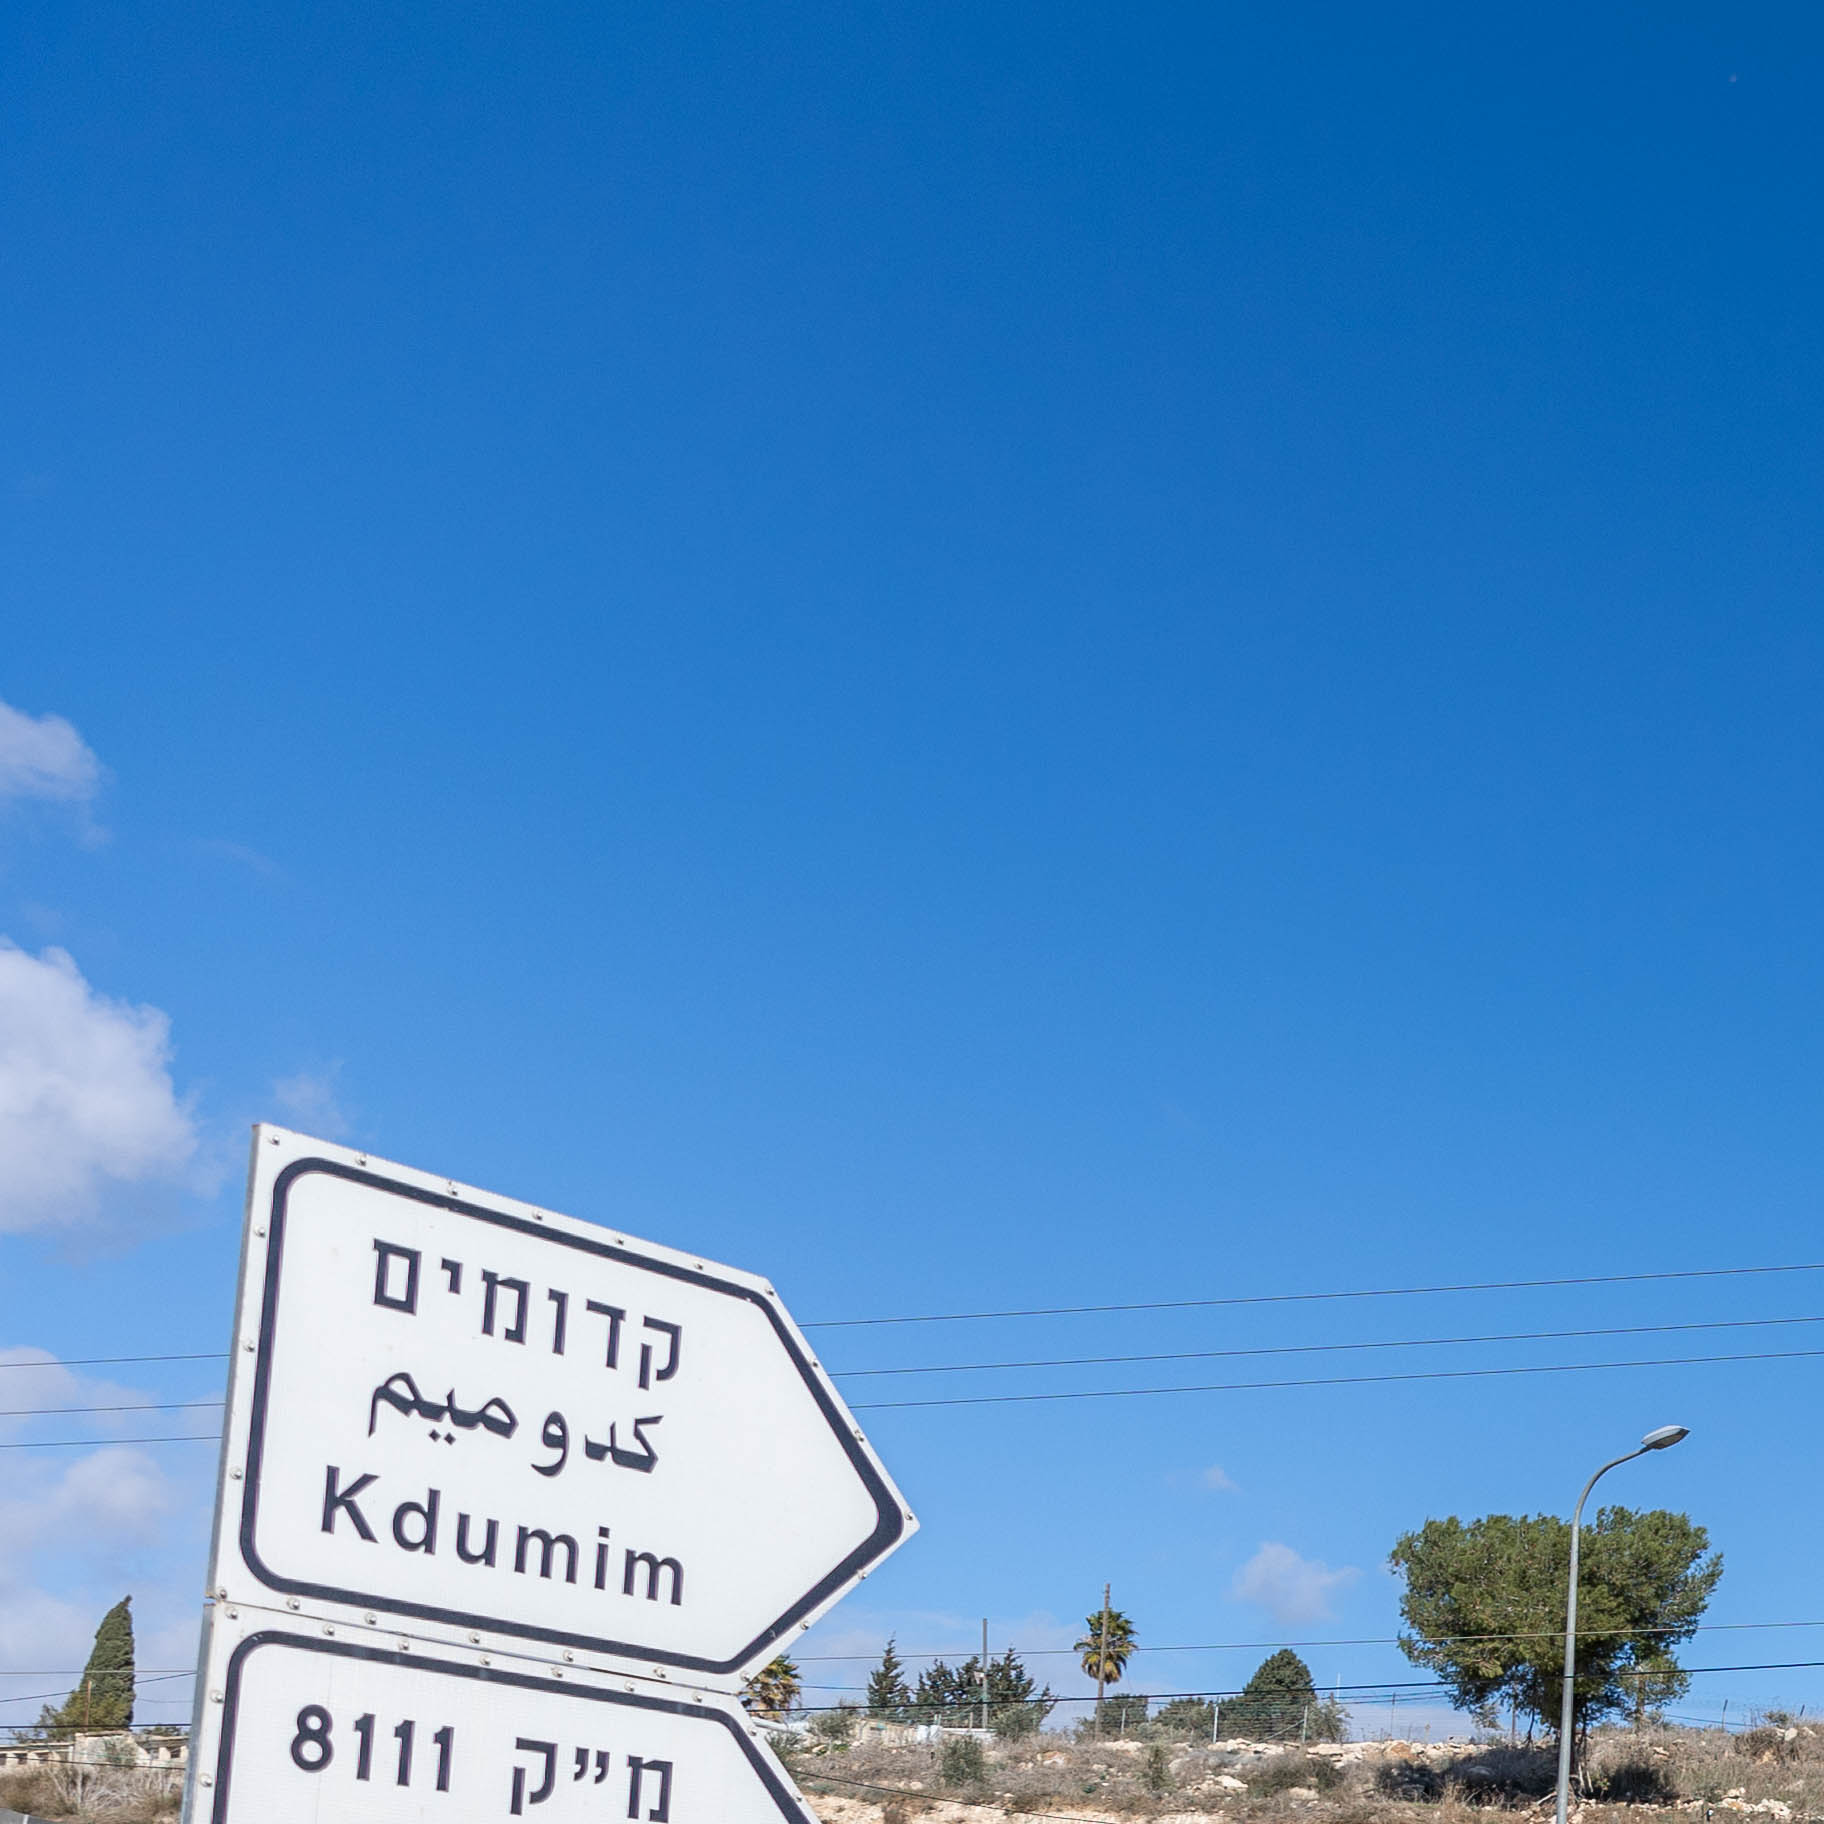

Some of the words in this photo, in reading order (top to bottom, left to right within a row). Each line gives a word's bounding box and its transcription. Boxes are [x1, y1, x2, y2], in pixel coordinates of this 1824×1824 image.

[373, 1238, 682, 1390] קדומים
[368, 1371, 664, 1478] كدوميم
[321, 1464, 684, 1606] Kdumim
[290, 1703, 455, 1793] 8111
